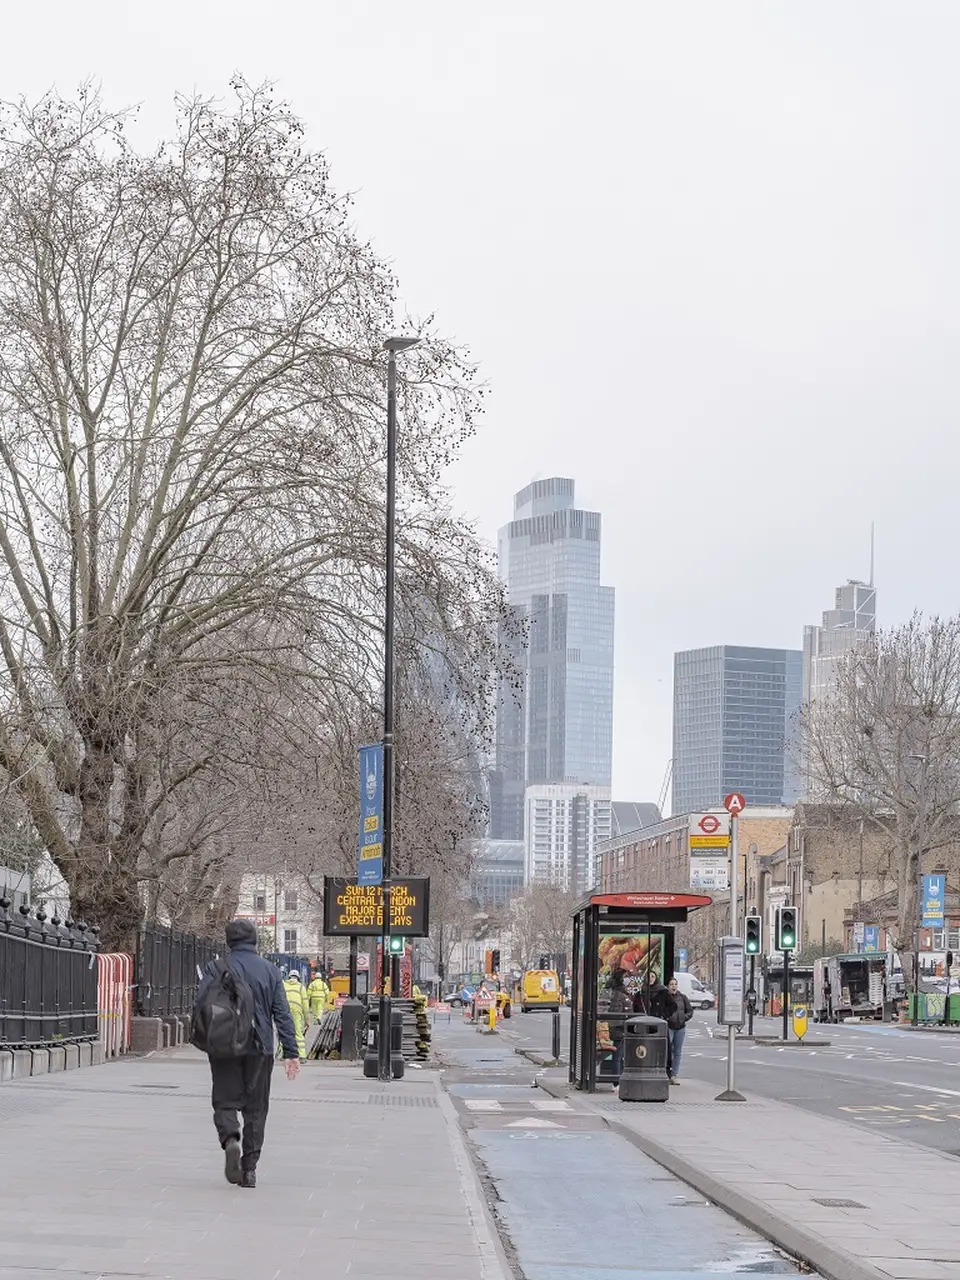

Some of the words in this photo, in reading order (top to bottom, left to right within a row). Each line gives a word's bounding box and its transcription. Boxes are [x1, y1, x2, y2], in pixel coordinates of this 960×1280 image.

[729, 794, 742, 810] A
[345, 885, 365, 896] SUN
[366, 886, 376, 896] 12
[377, 886, 408, 896] MRCH
[337, 896, 378, 906] CENTRAL
[380, 896, 416, 906] LNDON
[345, 906, 376, 916] MAJOR
[377, 906, 406, 916] EENT
[339, 916, 375, 926] EXPECT
[376, 916, 412, 926] DLAYS
